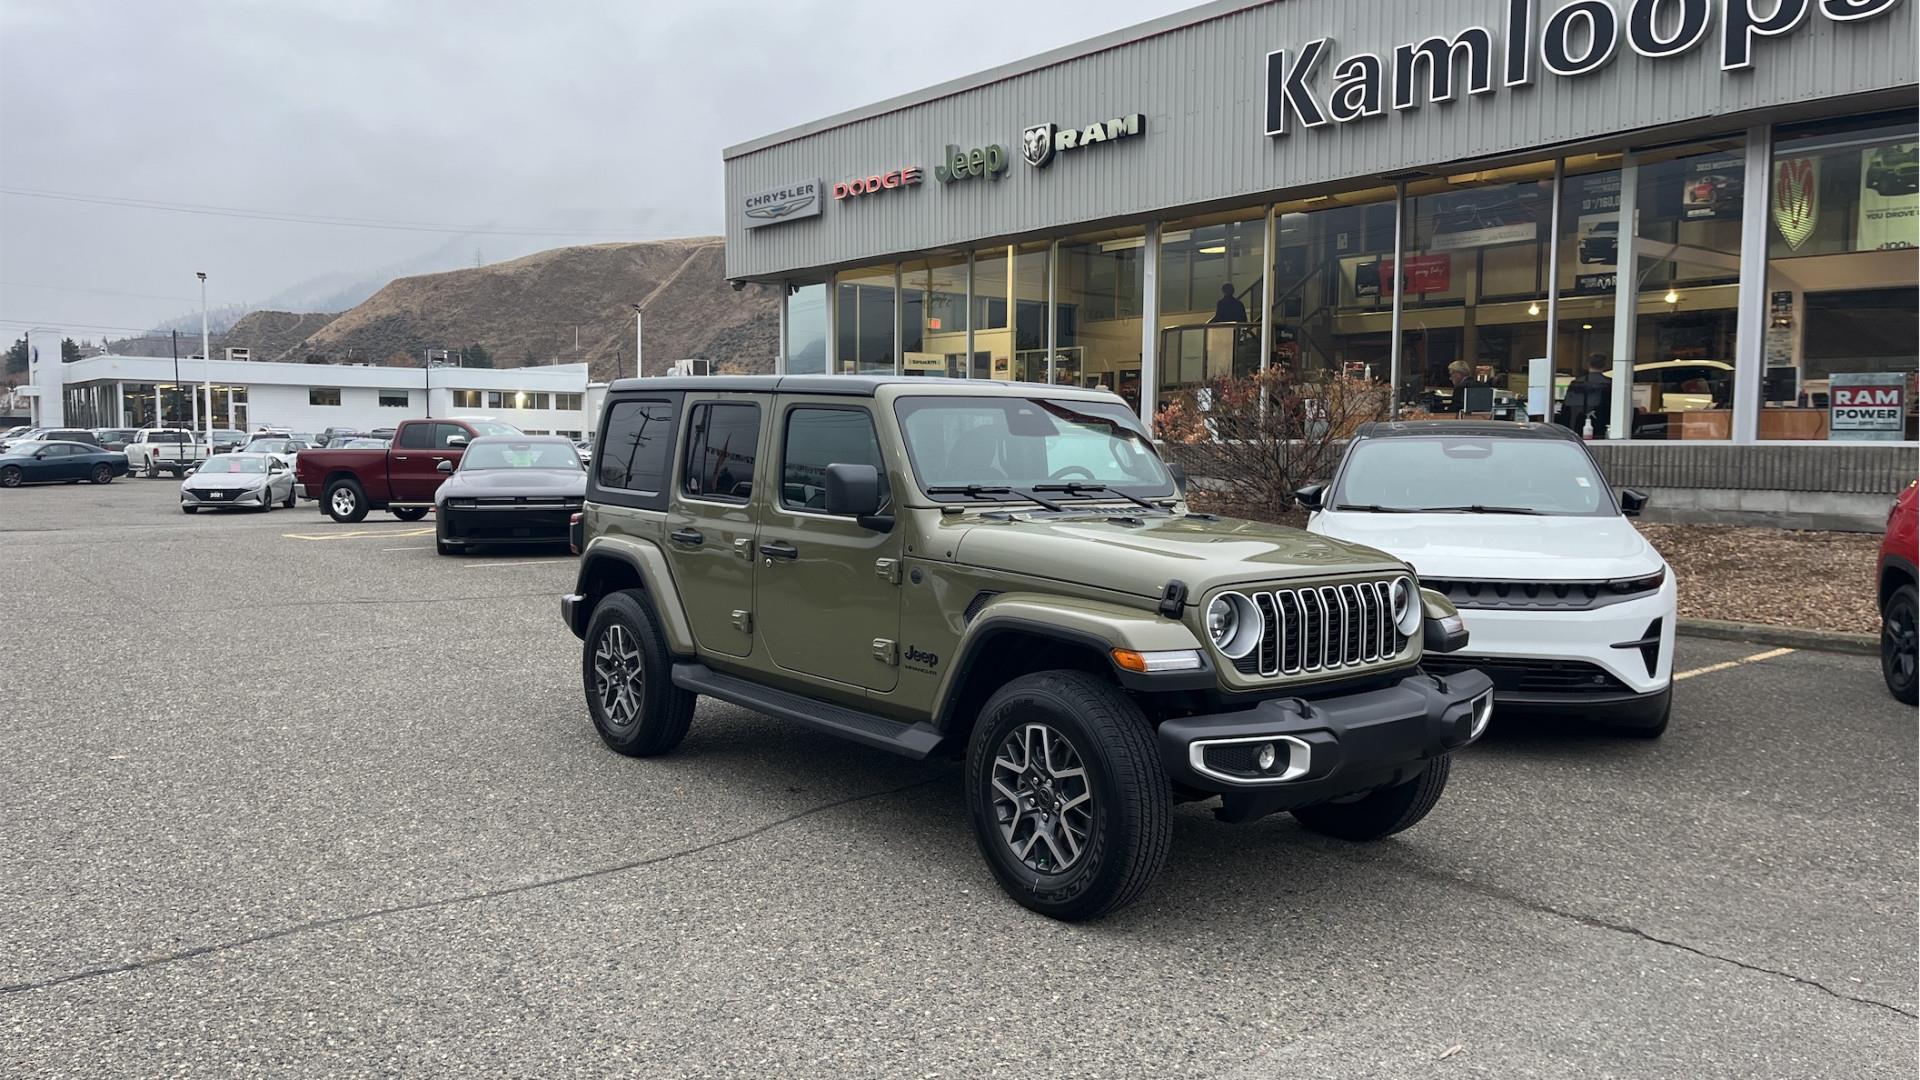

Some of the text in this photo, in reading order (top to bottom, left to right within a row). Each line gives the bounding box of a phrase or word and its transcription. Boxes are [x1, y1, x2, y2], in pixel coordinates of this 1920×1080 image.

[1264, 0, 1897, 136] Kamloop
[1055, 113, 1144, 151] RAM
[934, 144, 1008, 183] Jeep
[745, 184, 814, 208] CHRYSLER
[833, 167, 922, 200] DODGE
[1835, 390, 1898, 405] RAM
[1835, 409, 1897, 419] POWER
[904, 644, 938, 668] Jeep
